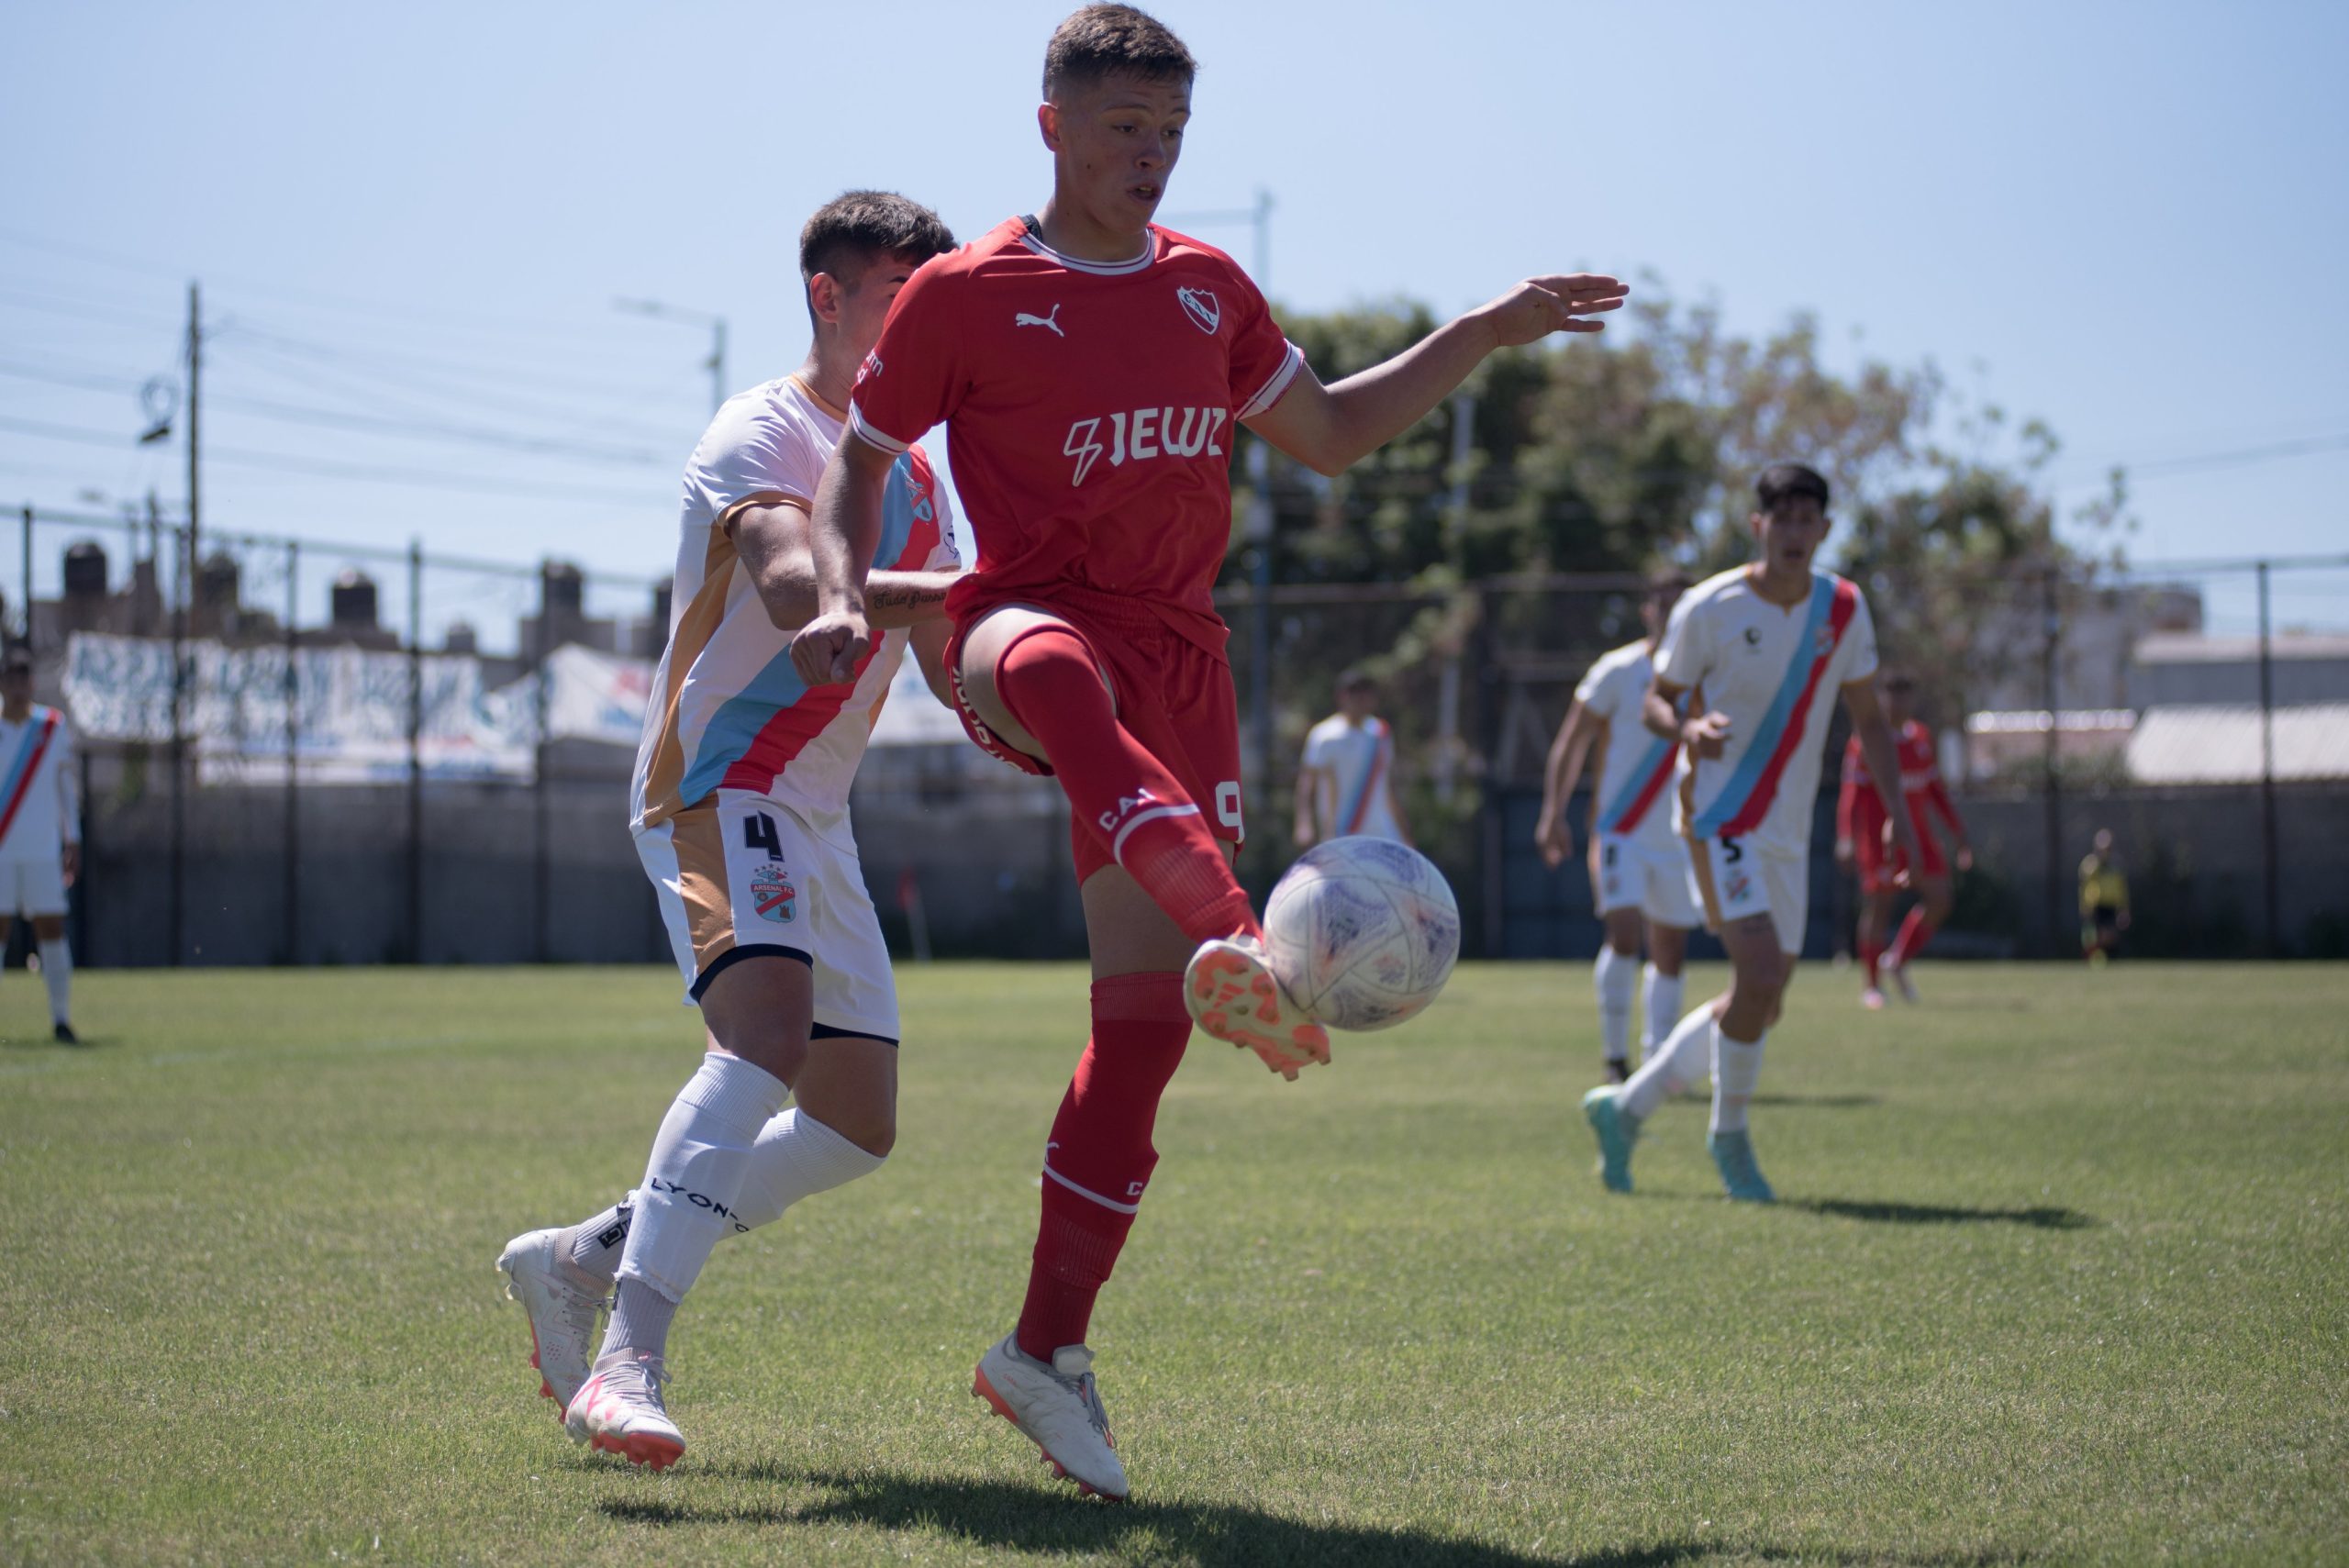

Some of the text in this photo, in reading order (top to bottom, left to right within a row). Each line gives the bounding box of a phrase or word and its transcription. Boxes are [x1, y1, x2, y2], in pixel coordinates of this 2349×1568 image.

[743, 810, 785, 862] 4
[1215, 781, 1245, 844] 9
[1721, 835, 1742, 864] 5
